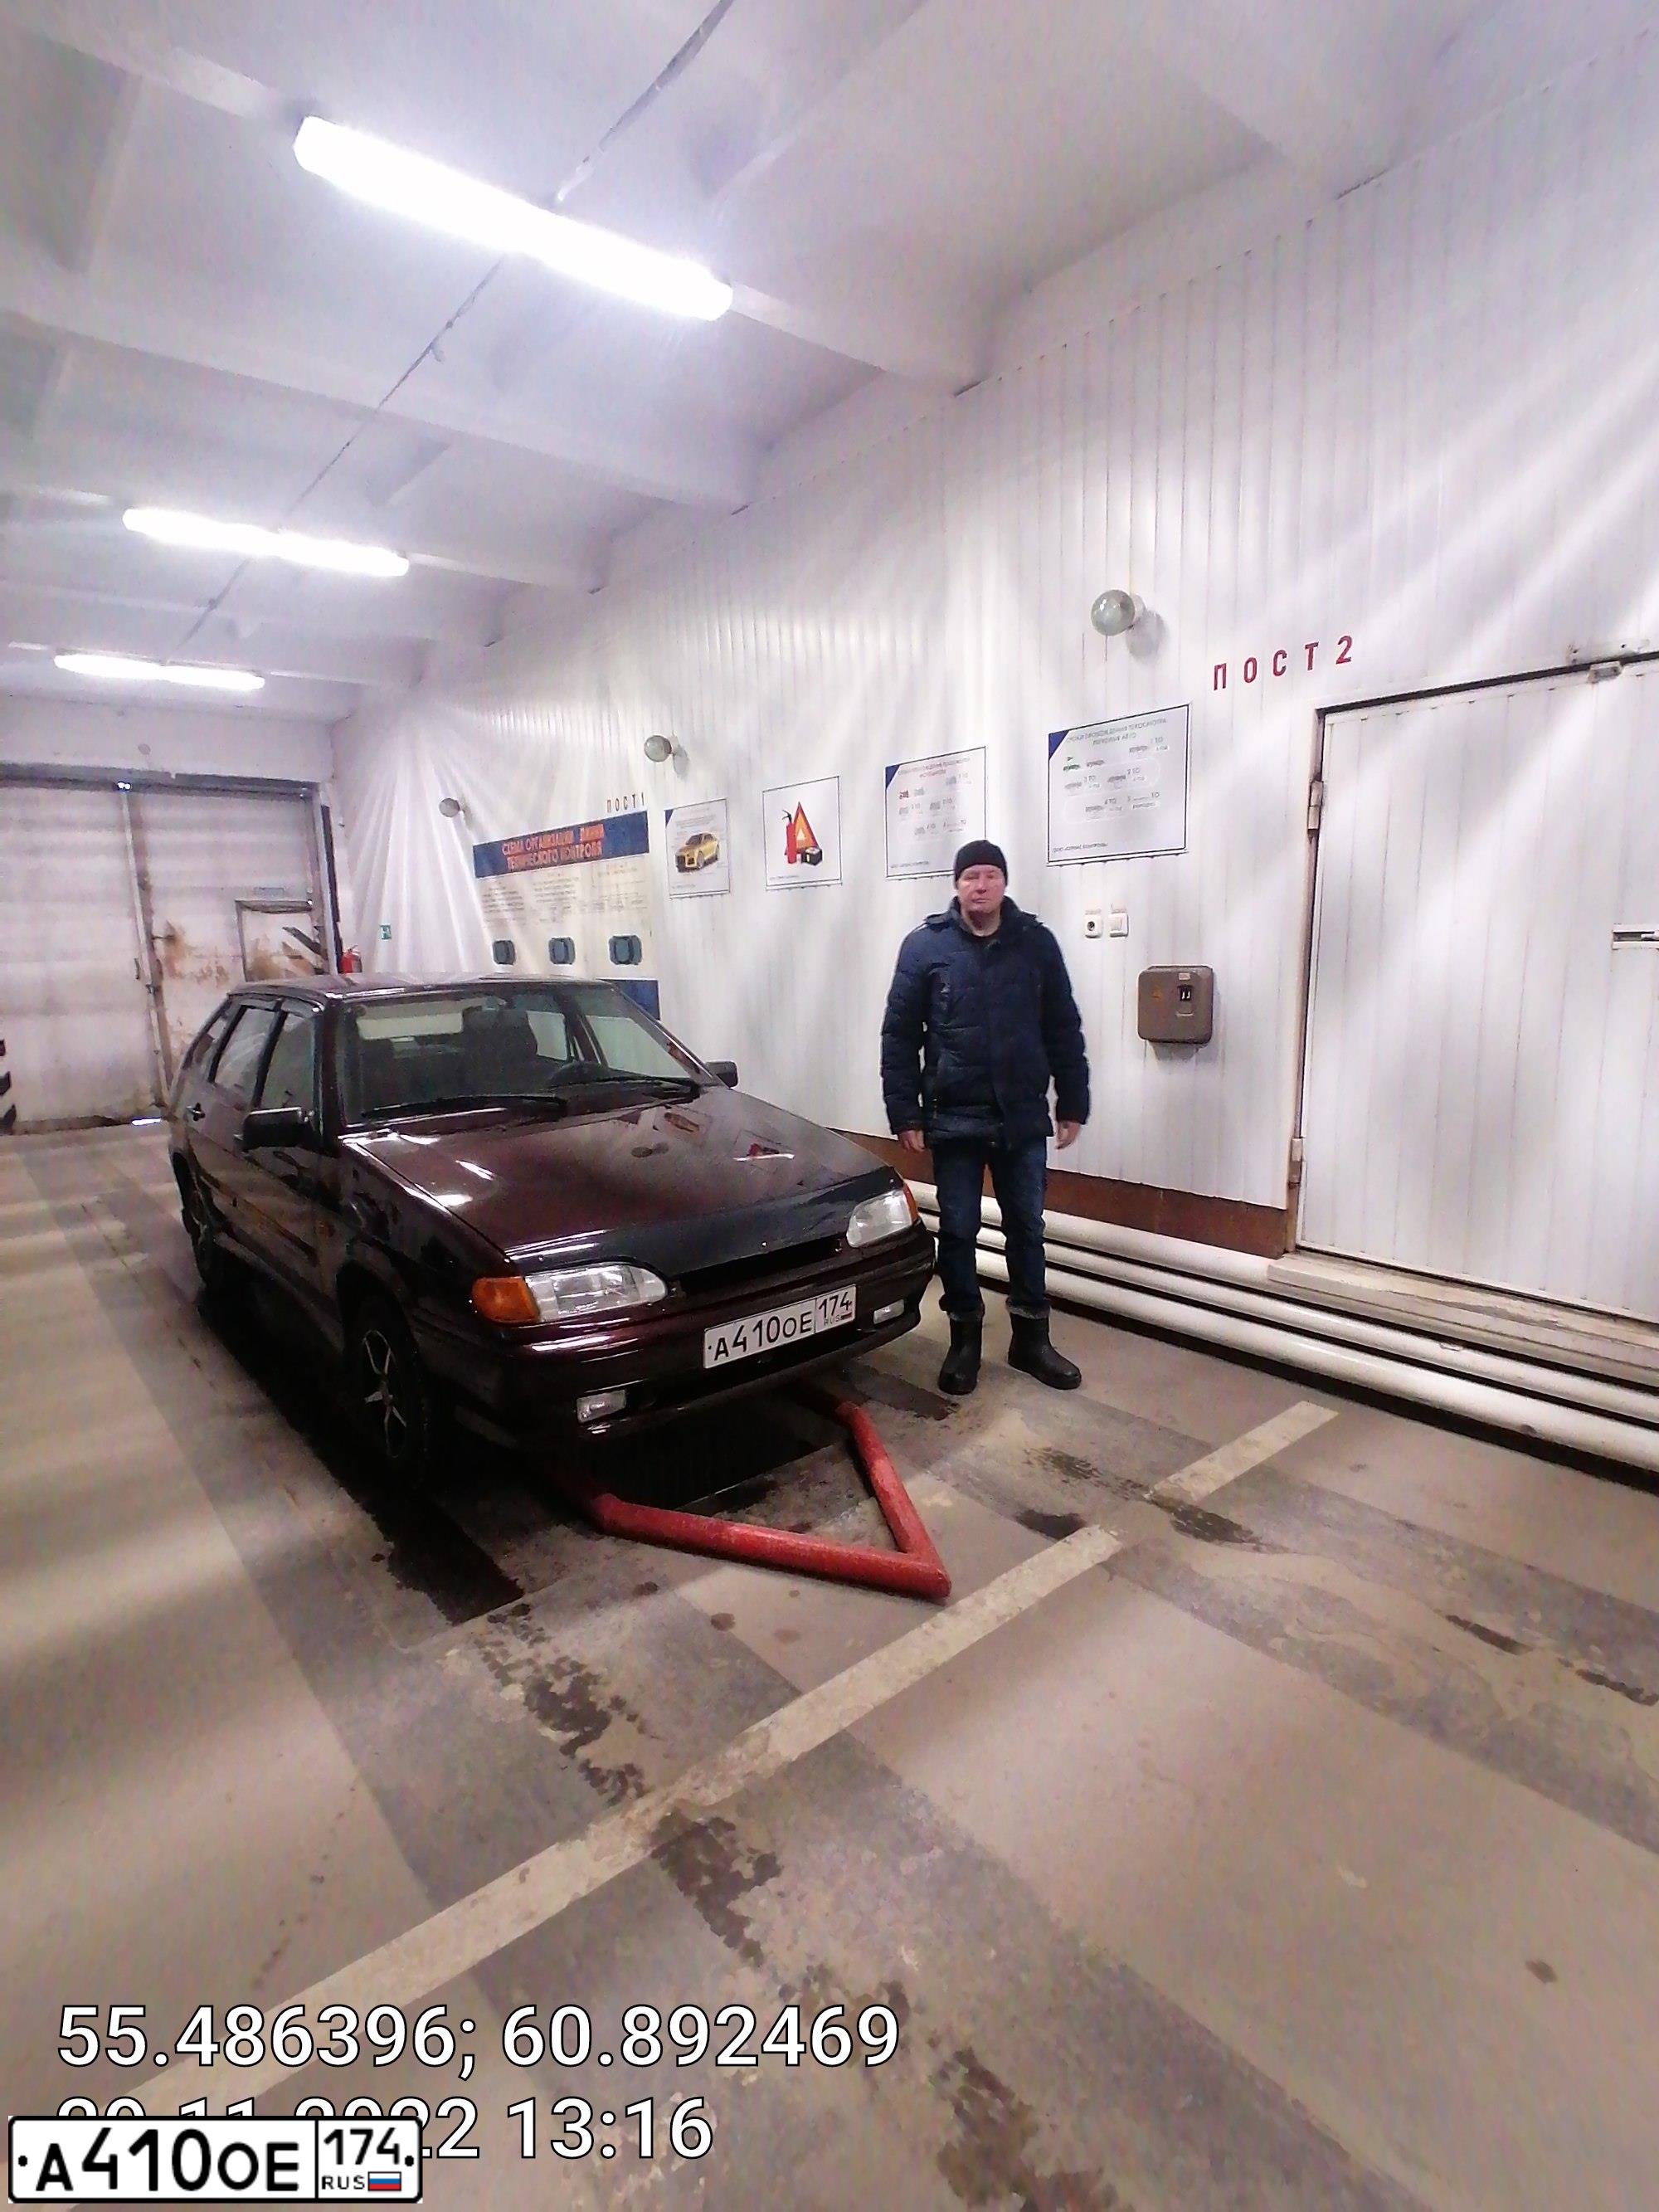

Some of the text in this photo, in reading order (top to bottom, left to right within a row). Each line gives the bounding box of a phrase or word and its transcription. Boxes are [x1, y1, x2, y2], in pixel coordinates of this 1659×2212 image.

[1214, 636, 1353, 691] ПОСТ 2
[606, 794, 637, 813] ПОСТ
[819, 1291, 849, 1318] 174
